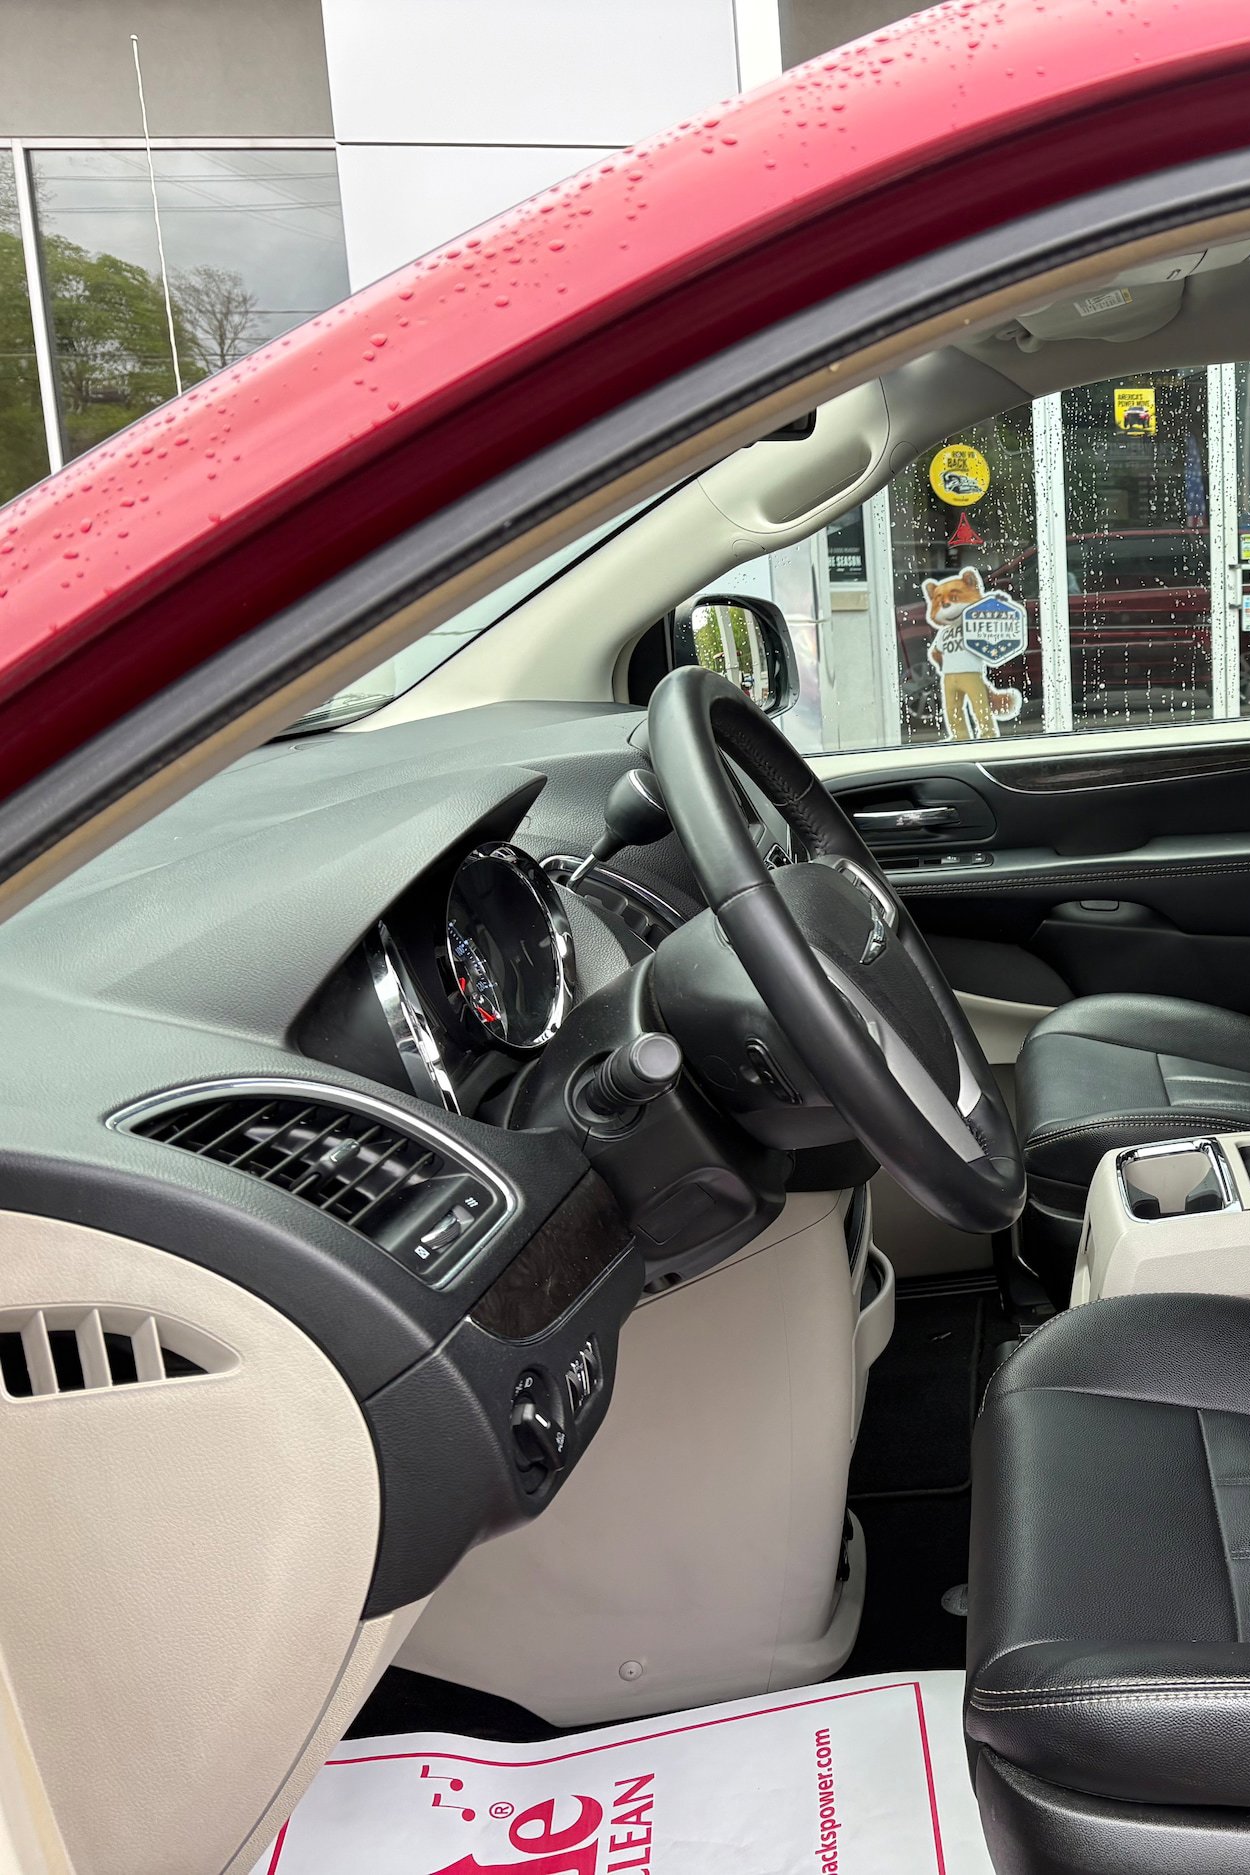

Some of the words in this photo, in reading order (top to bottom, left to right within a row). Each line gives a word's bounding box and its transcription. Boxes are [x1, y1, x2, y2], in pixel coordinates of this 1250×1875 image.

[965, 621, 1020, 633] LIFETIME
[607, 1773, 655, 1875] LEAN
[815, 1728, 841, 1875] ackspower.com
